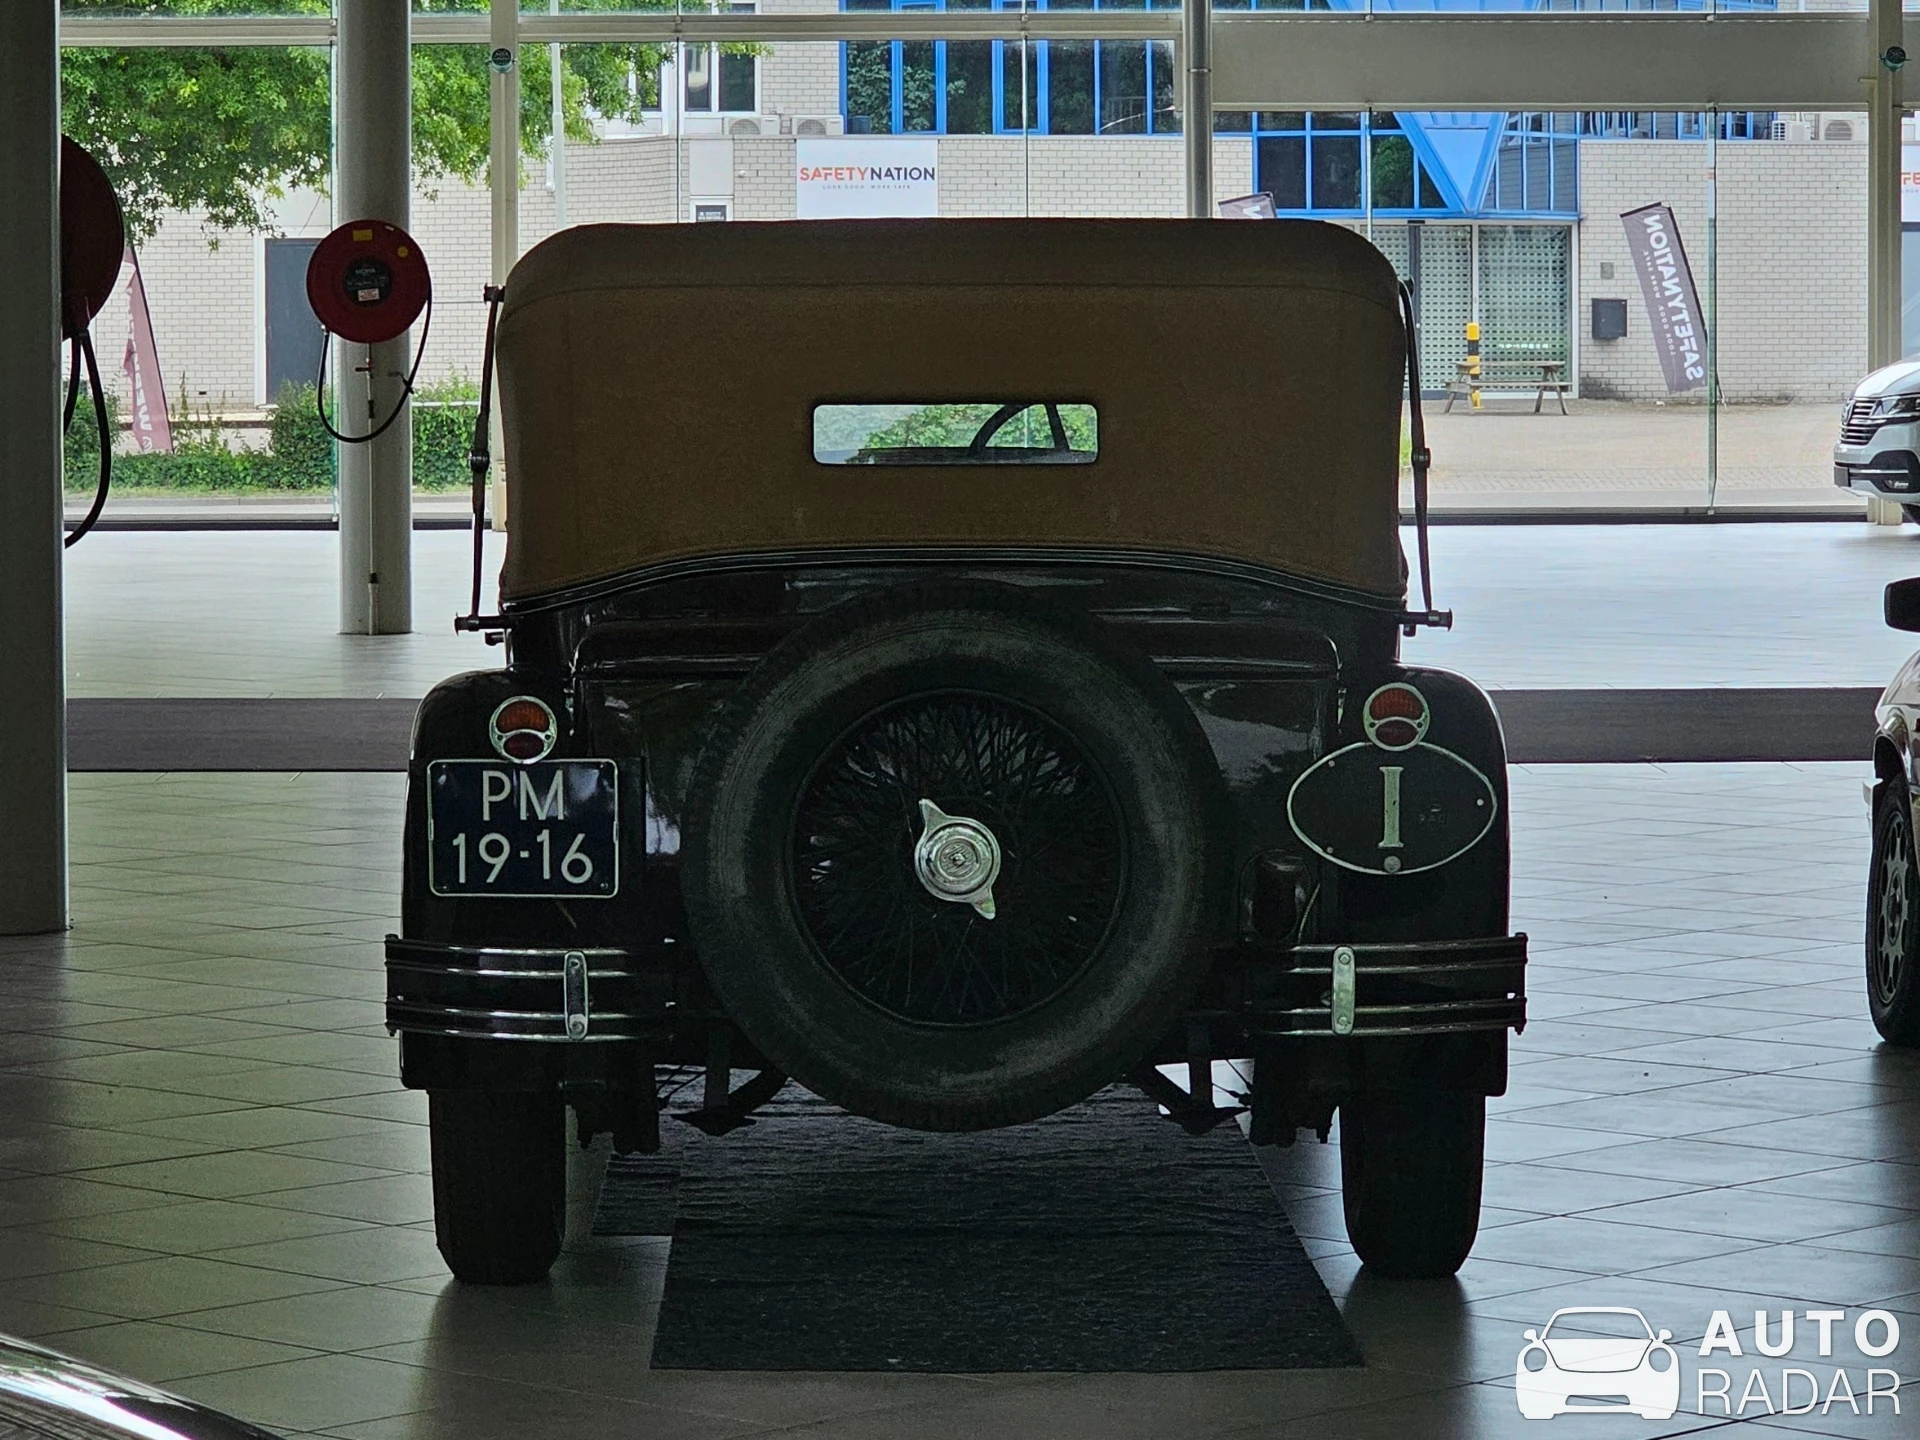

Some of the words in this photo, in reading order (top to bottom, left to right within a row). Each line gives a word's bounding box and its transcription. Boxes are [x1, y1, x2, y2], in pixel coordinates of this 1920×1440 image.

[800, 167, 935, 181] SAFETYNATION
[482, 769, 566, 821] PM
[1378, 765, 1405, 848] I
[452, 829, 594, 884] 19-16
